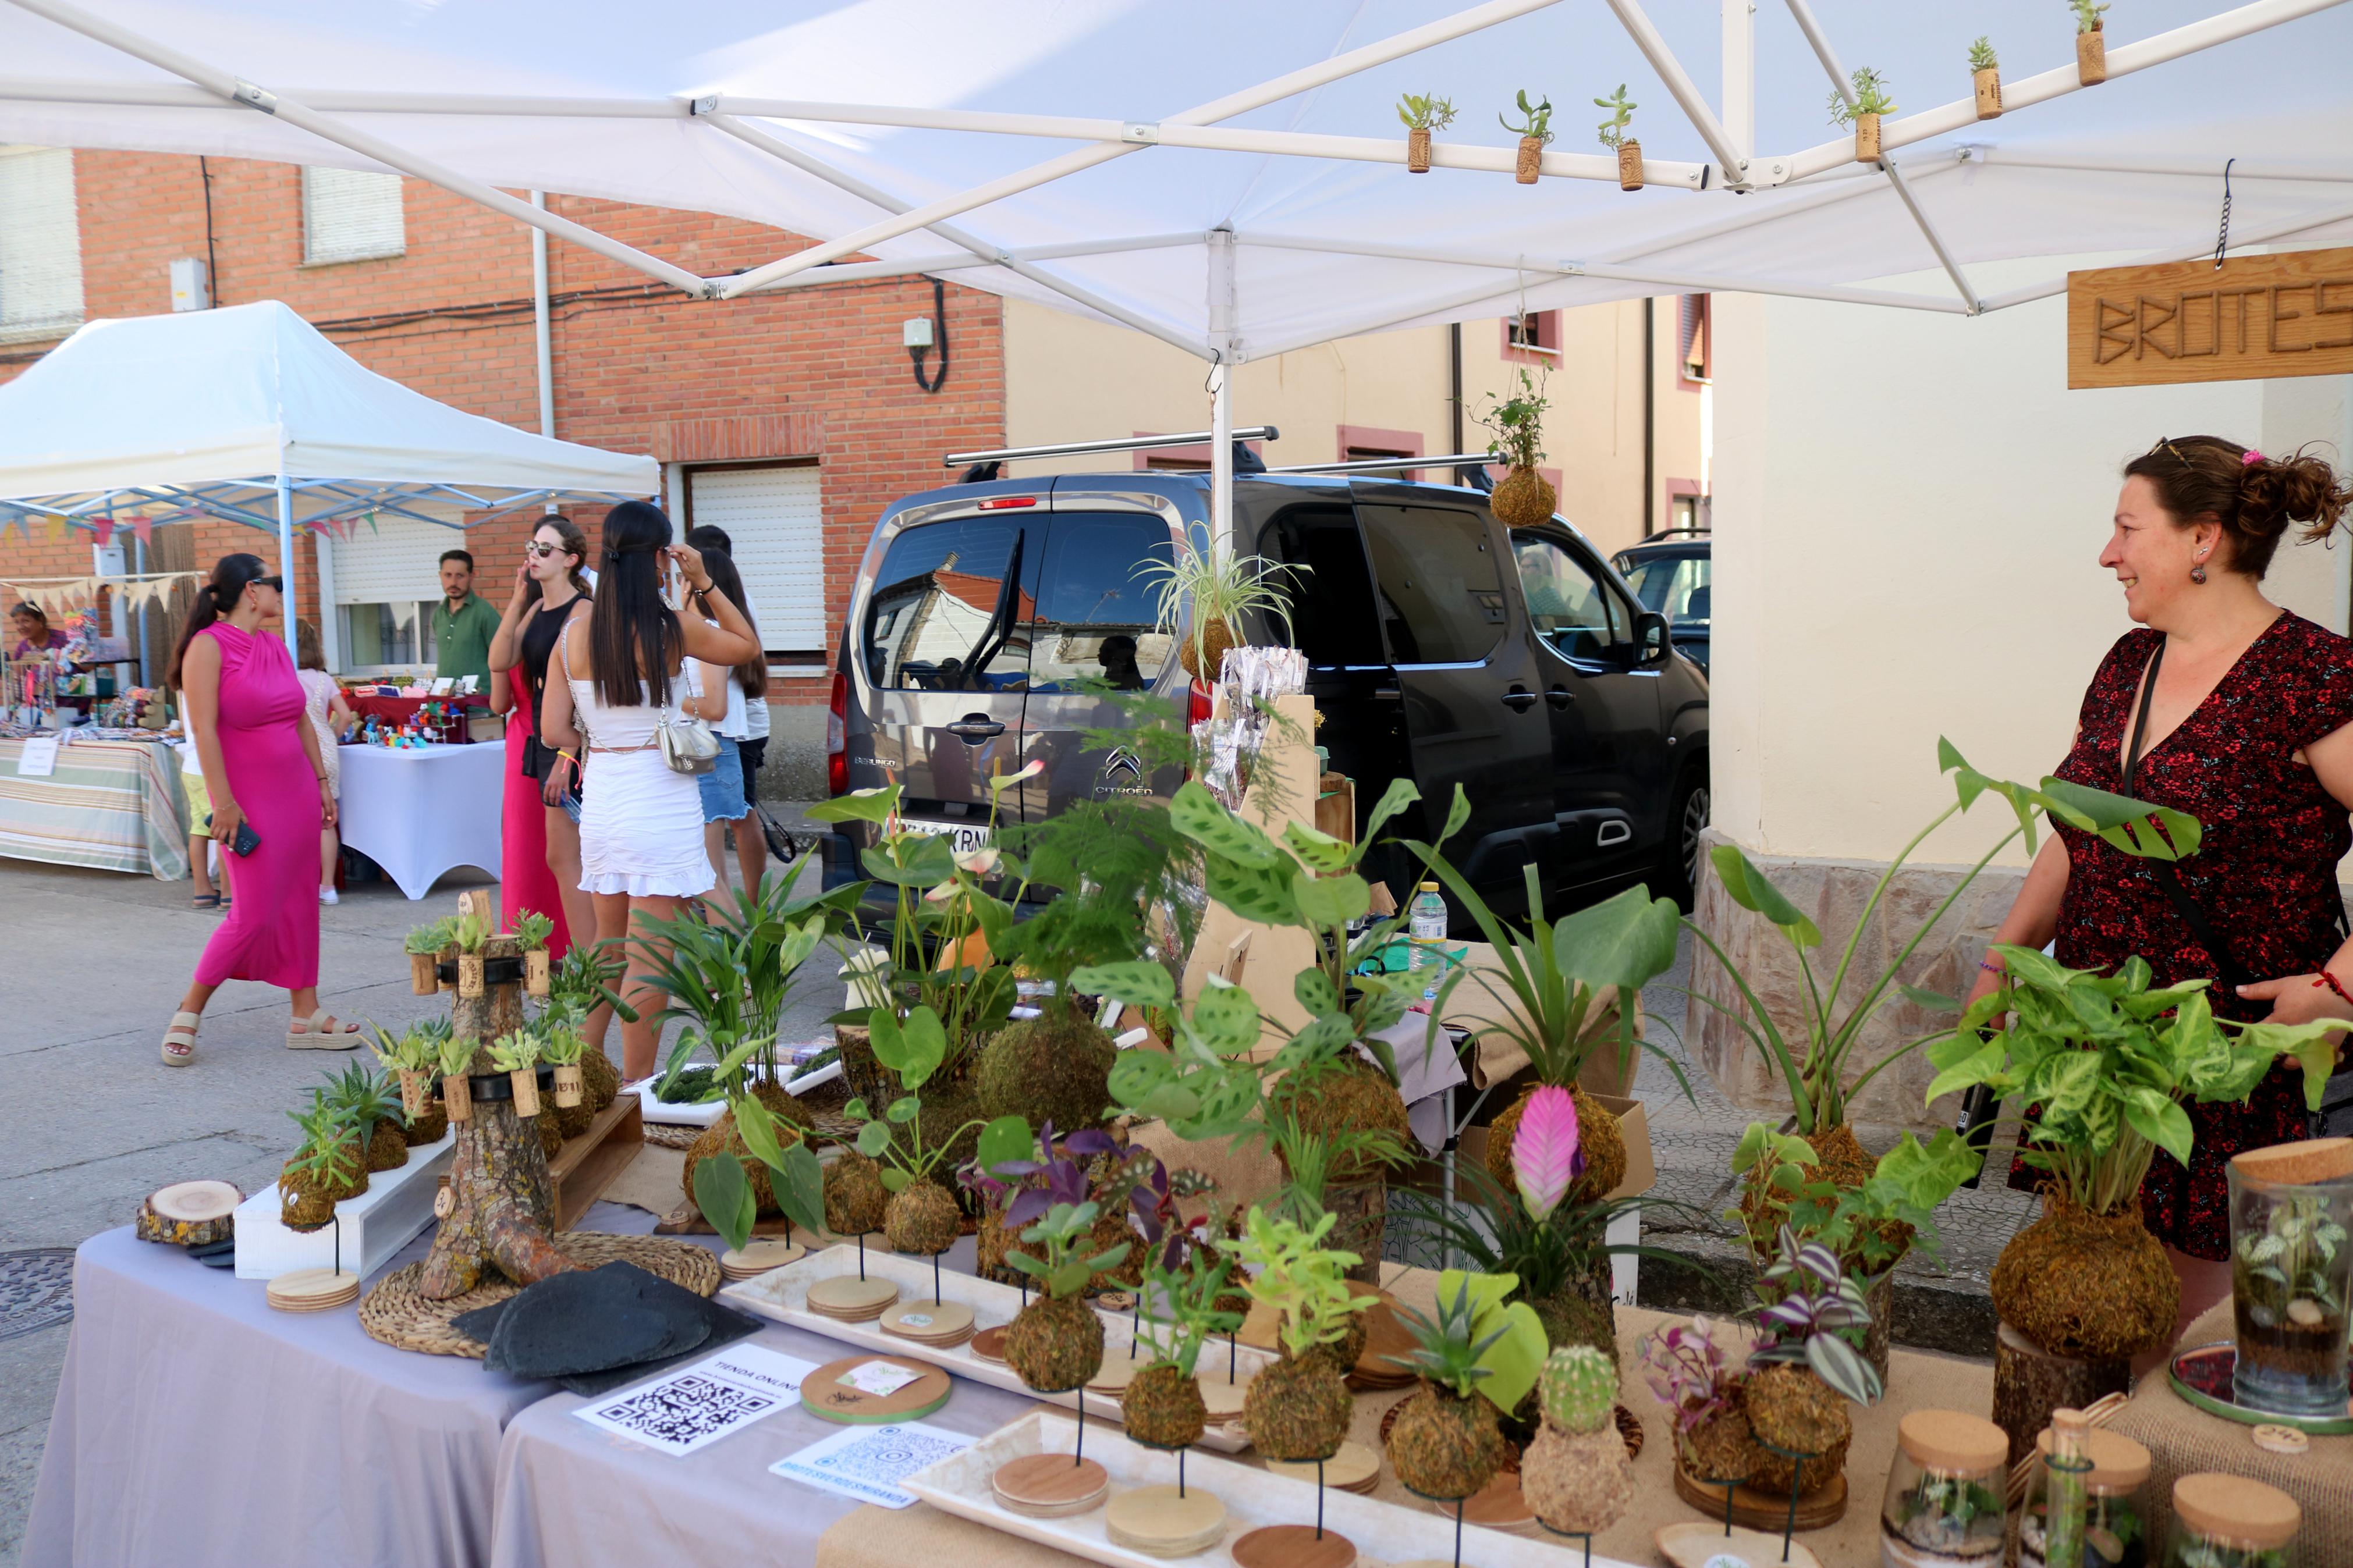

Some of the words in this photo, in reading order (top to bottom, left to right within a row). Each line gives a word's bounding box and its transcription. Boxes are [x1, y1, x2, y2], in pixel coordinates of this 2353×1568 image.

[2093, 279, 2353, 364] BROTES
[854, 756, 896, 767] BERLINGO
[1095, 785, 1154, 796] CITROËN
[715, 1361, 756, 1378] TIENDA
[755, 1374, 800, 1392] ONLINE
